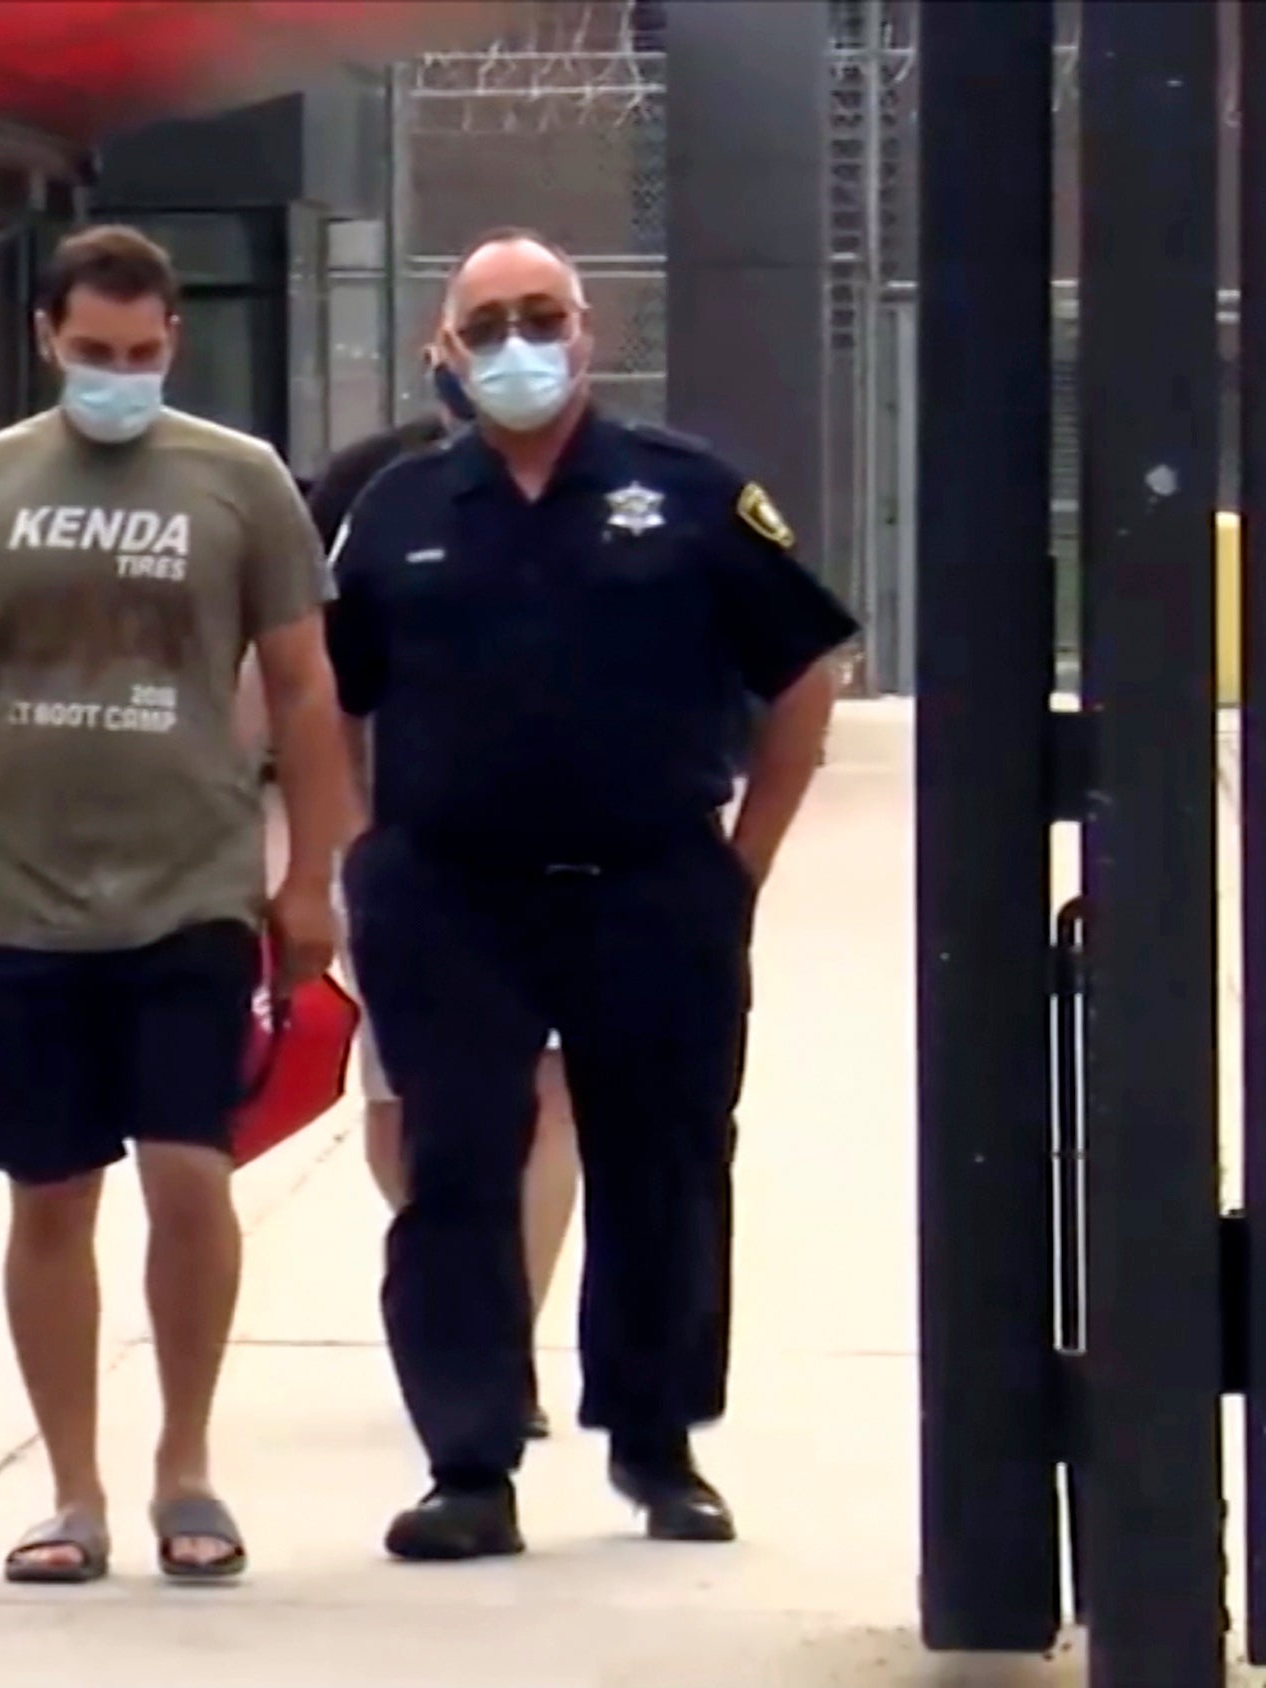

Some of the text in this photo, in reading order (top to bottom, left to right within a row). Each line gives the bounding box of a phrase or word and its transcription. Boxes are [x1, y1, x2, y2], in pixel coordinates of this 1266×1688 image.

[8, 505, 190, 555] KENDA
[116, 555, 187, 581] TIRES
[35, 702, 102, 728] BOOT
[104, 705, 176, 732] CAMP
